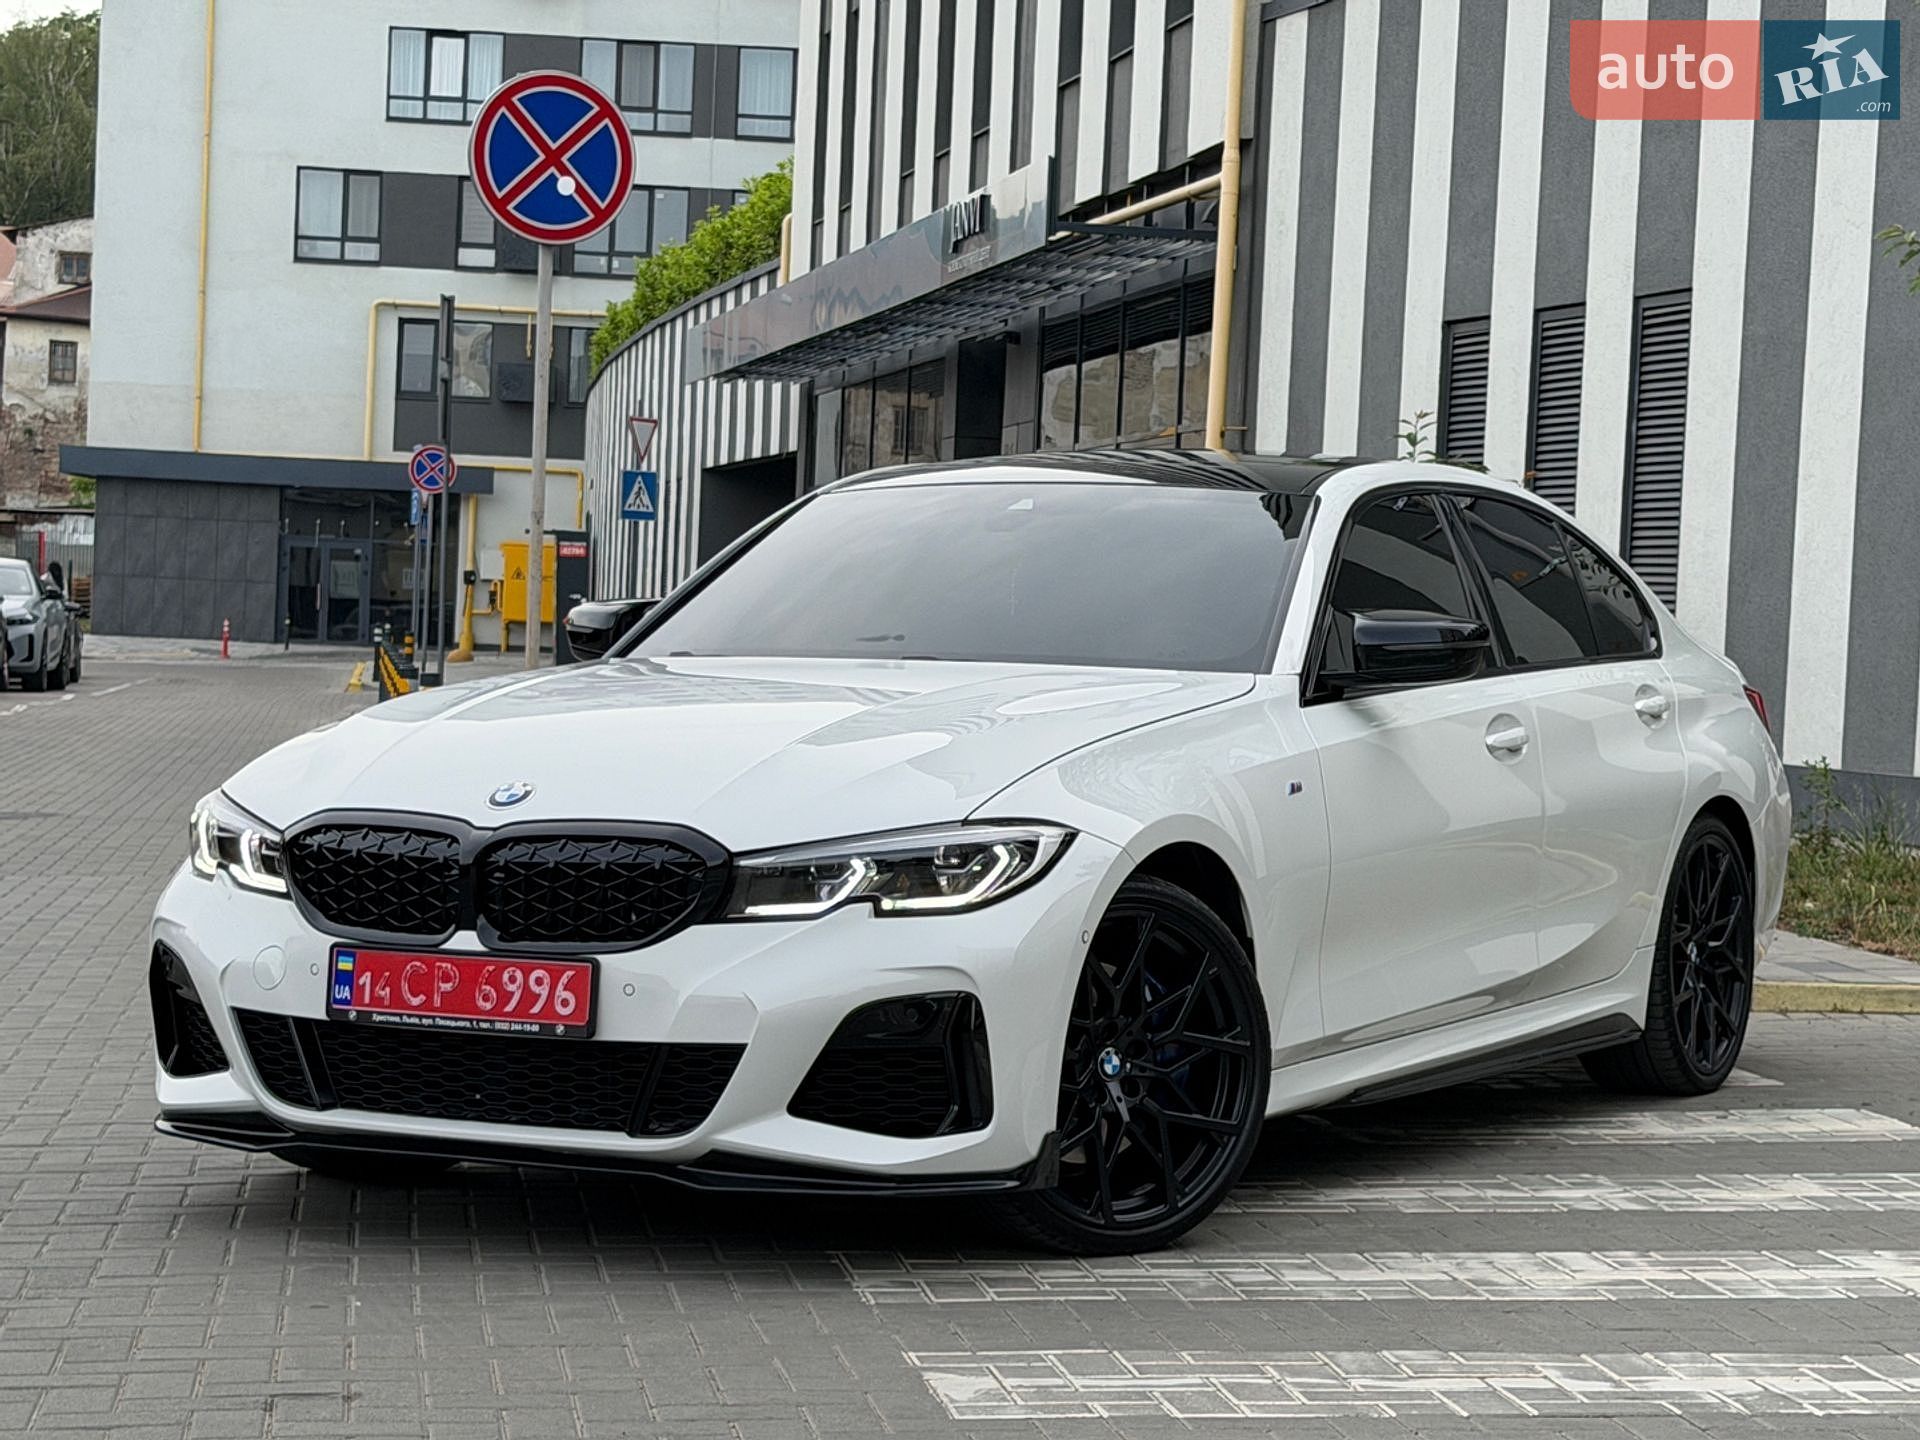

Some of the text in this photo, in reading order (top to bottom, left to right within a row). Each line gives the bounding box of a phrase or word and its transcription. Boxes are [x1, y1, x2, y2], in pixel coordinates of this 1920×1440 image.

[335, 984, 351, 1001] UA
[358, 970, 391, 1007] 14
[475, 965, 577, 1017] 6996
